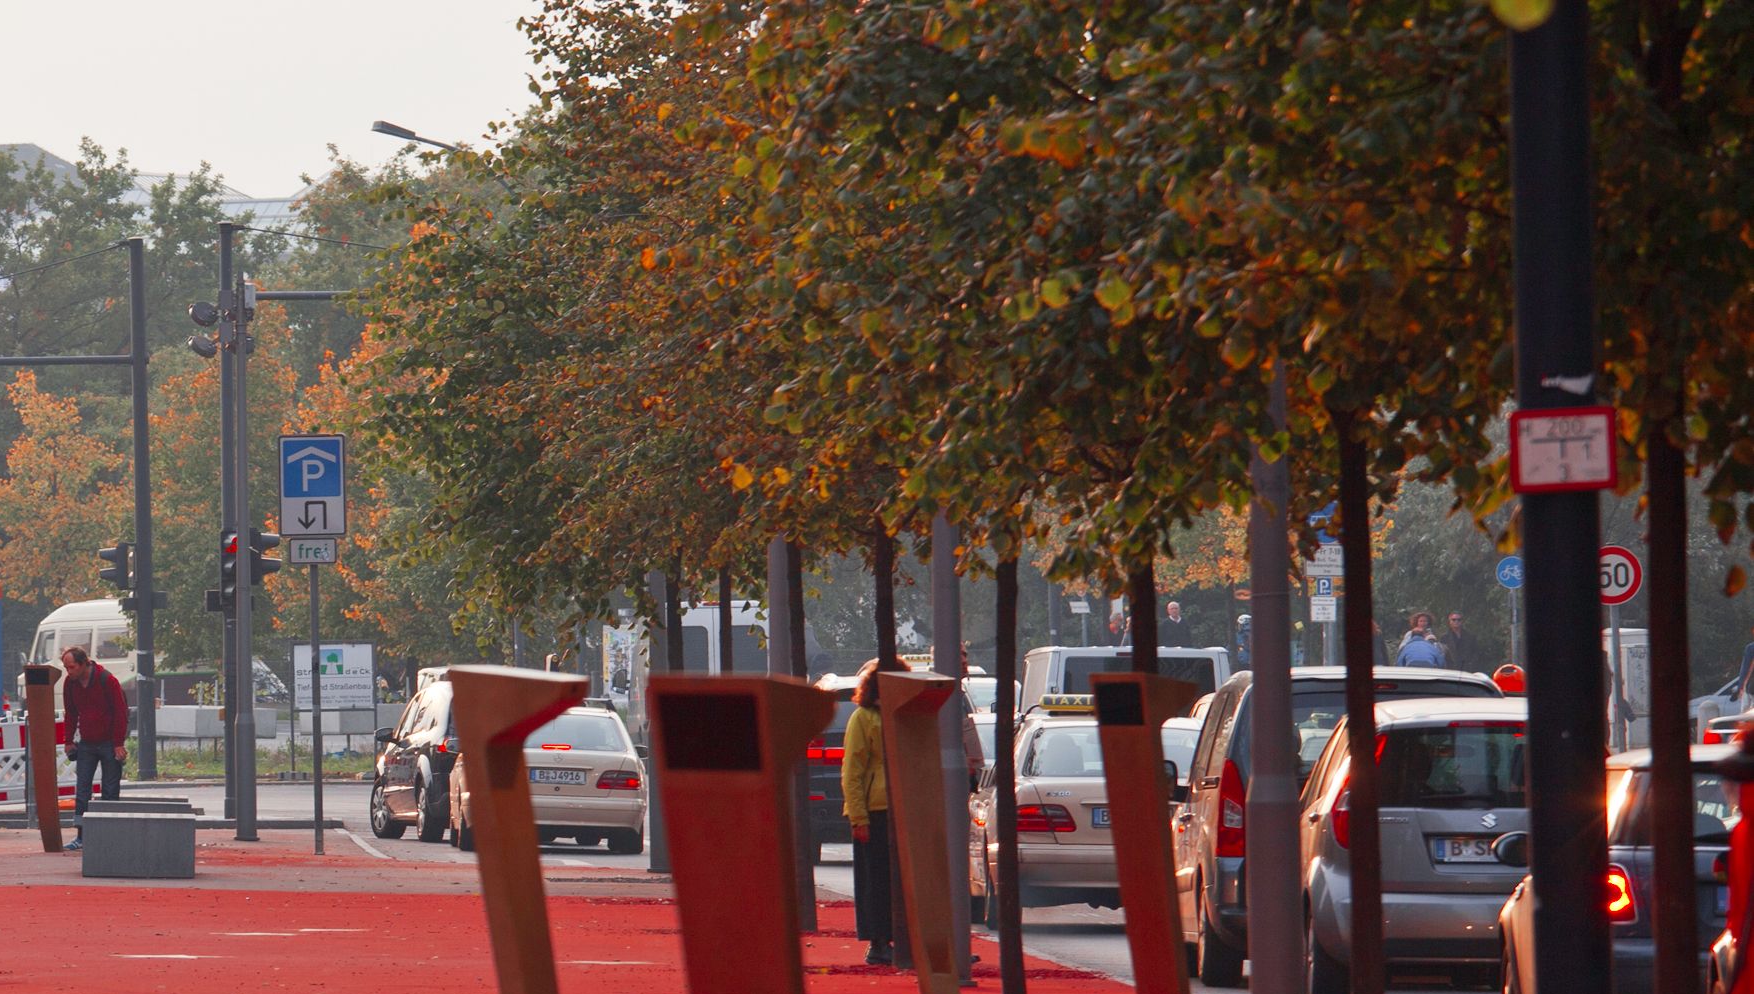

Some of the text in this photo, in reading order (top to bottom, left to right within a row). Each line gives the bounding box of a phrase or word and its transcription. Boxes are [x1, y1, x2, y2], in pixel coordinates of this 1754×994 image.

[302, 459, 326, 493] P
[1600, 562, 1629, 588] 50
[1051, 695, 1092, 705] TAXI
[539, 771, 545, 780] B
[1451, 841, 1463, 857] B
